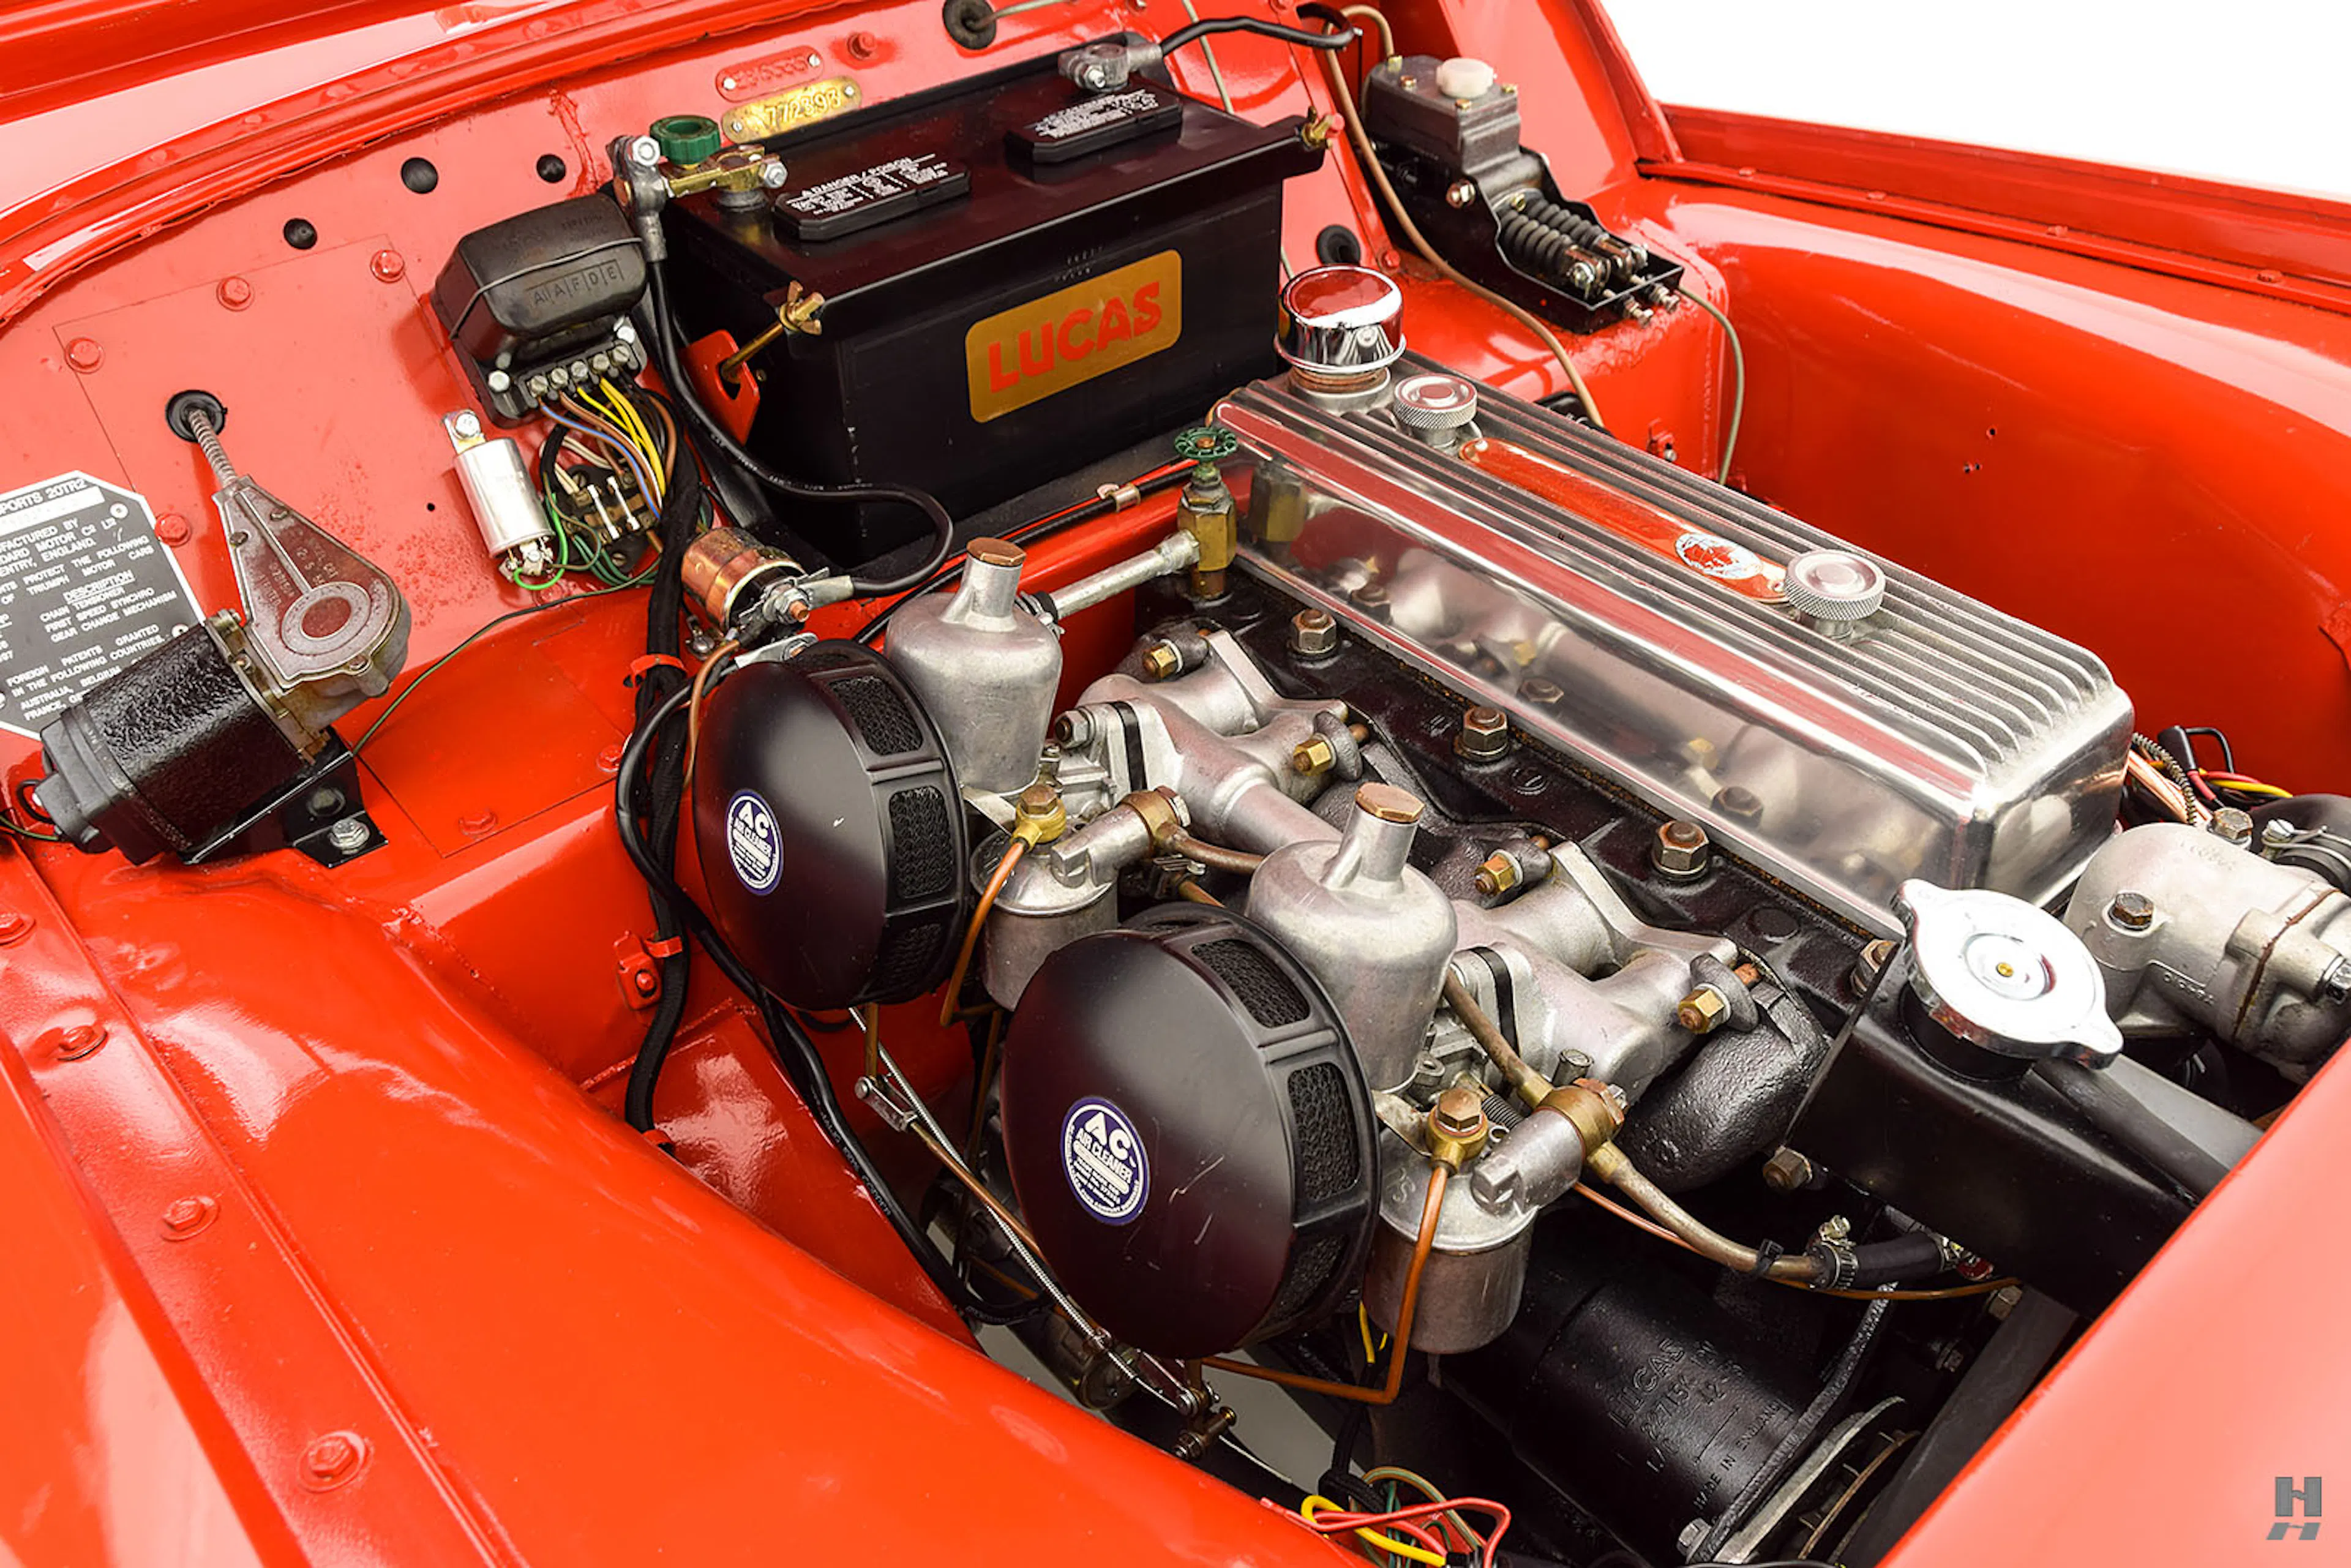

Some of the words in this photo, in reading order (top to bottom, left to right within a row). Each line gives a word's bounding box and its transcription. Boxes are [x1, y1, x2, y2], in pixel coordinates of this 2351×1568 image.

[589, 272, 598, 285] D
[609, 266, 617, 279] E
[988, 280, 1162, 394] LUCAS
[45, 478, 87, 499] 20TR2
[35, 531, 77, 552] MOTOR
[62, 518, 79, 531] BY
[23, 564, 65, 584] PROTECT
[71, 555, 92, 568] THE
[96, 535, 149, 560] FOLLOWING
[40, 537, 96, 562] ENGLAND.
[1, 593, 15, 605] OF
[26, 574, 70, 596] TRIUMPH
[81, 558, 116, 577] MOTOR
[128, 545, 154, 560] CARS
[63, 569, 135, 602] DESCRIPTION
[39, 605, 70, 623] CHAIN
[72, 586, 126, 610] TENSIONER
[45, 616, 72, 633] FIRST
[75, 604, 107, 621] SPEED
[110, 587, 155, 609] SYNCHRO
[51, 626, 78, 643] GEAR
[80, 612, 120, 631] CHANGE
[122, 590, 178, 617] MECHANISM
[6, 664, 50, 687] FOREIGN
[61, 644, 103, 667] PATENTS
[115, 623, 159, 647] GRANTED
[12, 686, 25, 698] IN
[26, 677, 48, 692] THE
[50, 656, 108, 683] FOLLOWING
[738, 801, 770, 839] AC
[1076, 1127, 1093, 1150] AIR
[1091, 1141, 1133, 1184] CLEANER
[1085, 1111, 1131, 1160] AC
[1608, 1337, 1685, 1430] LUCAS
[1693, 1473, 1722, 1510] MADE
[1720, 1454, 1736, 1471] IN
[1736, 1401, 1780, 1452] ENGLAND
